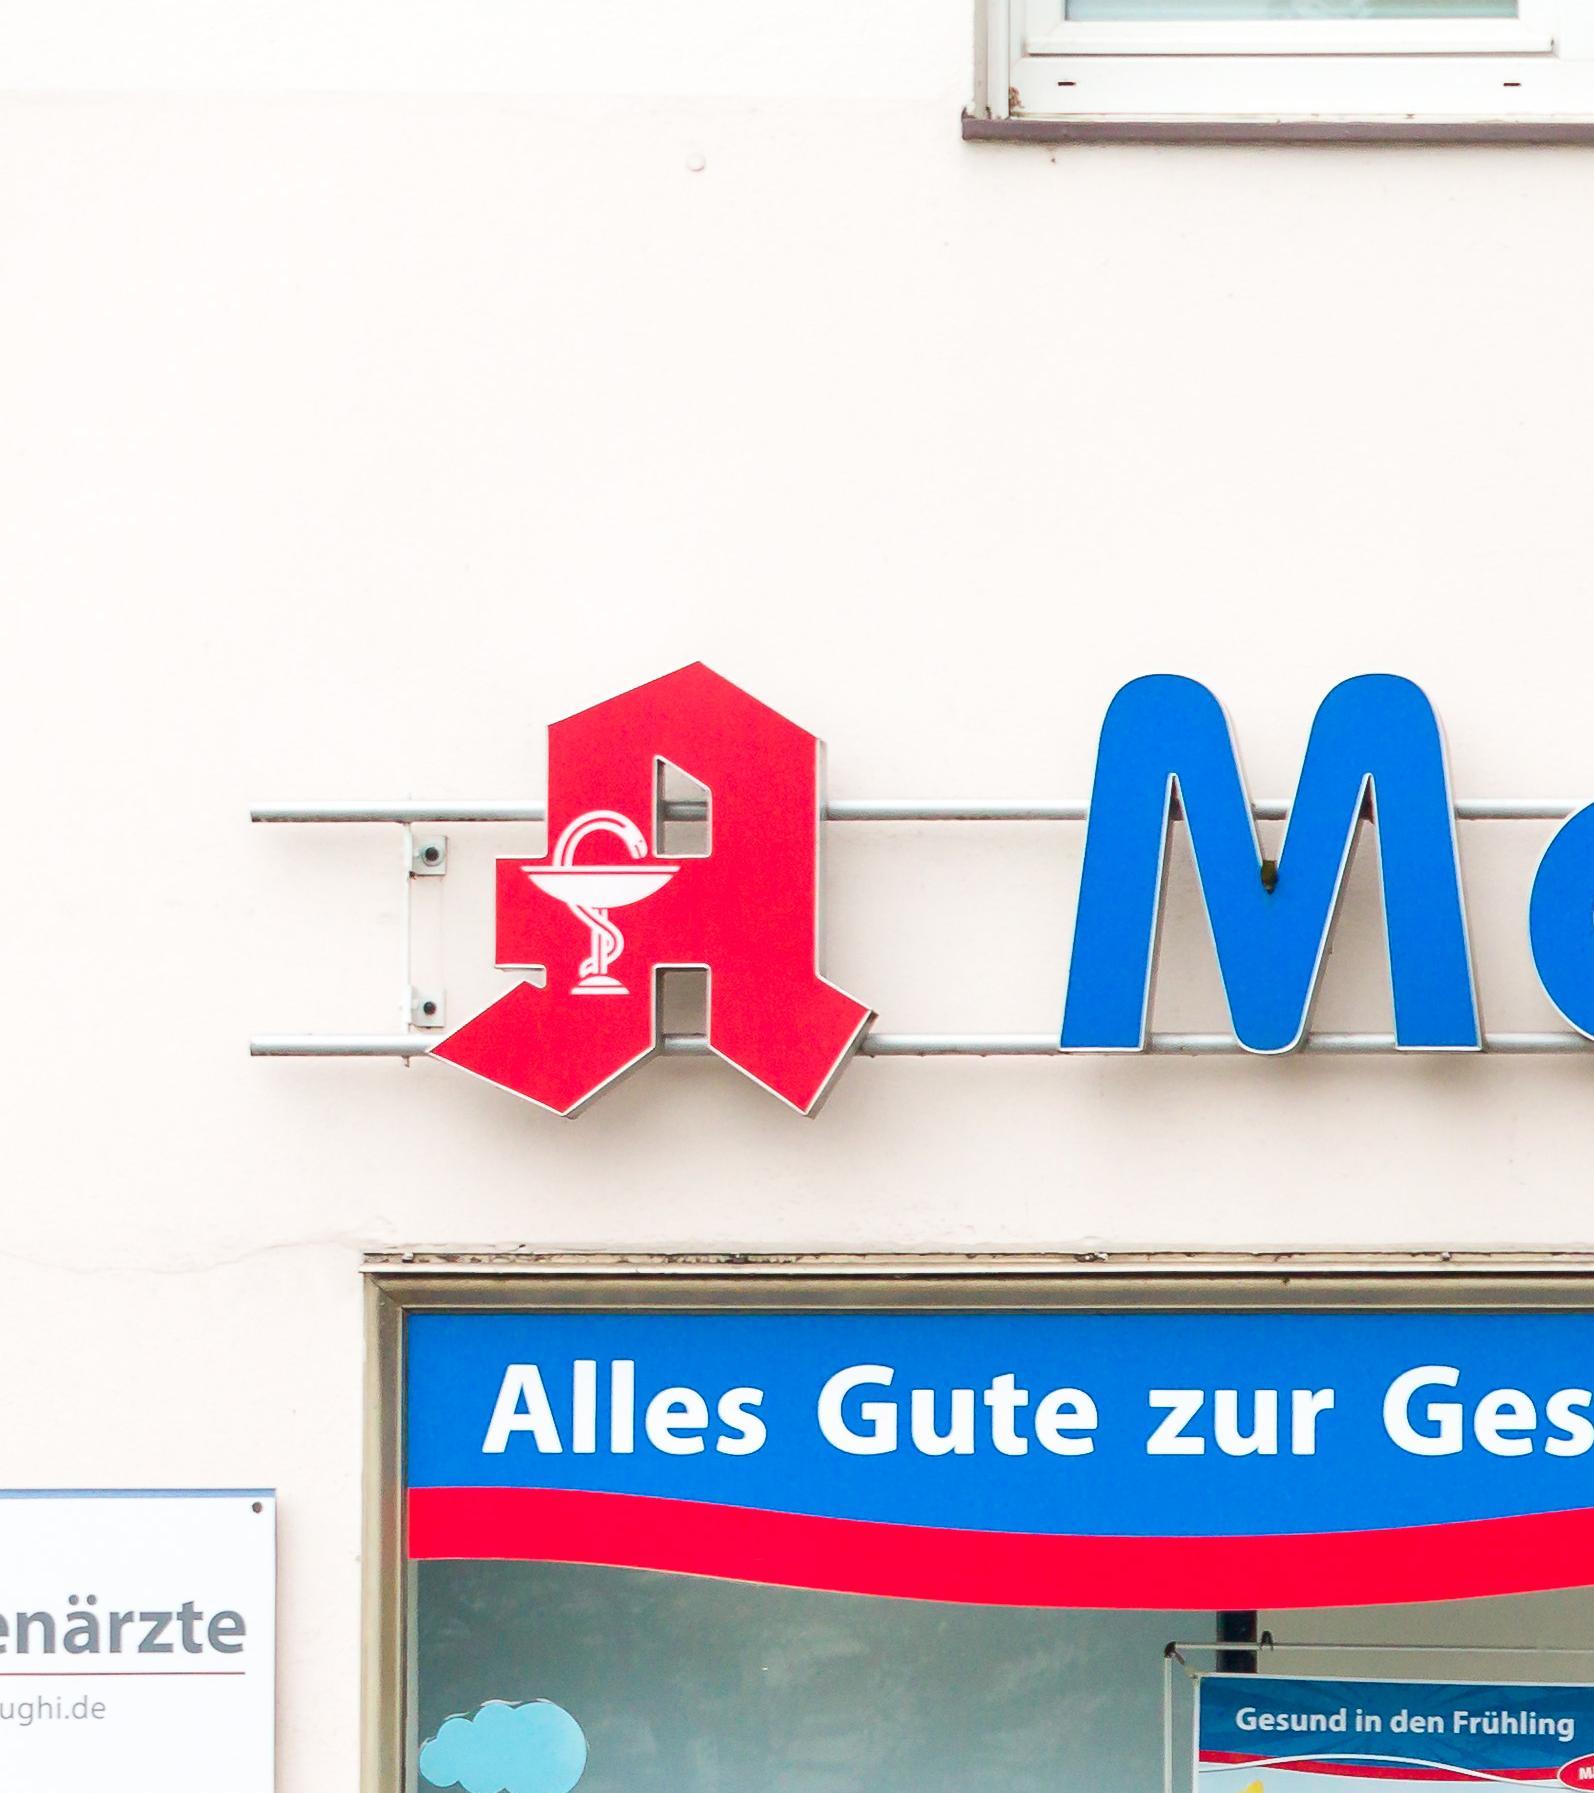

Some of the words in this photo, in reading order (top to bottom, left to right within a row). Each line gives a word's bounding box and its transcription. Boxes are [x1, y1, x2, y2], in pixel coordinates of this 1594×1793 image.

[482, 1361, 766, 1458] Alles
[817, 1363, 1098, 1458] Gute
[1146, 1386, 1335, 1457] zur
[1235, 1706, 1348, 1735] Gesund
[1355, 1709, 1383, 1735] in
[1390, 1708, 1445, 1736] den
[1452, 1708, 1576, 1743] Frühling
